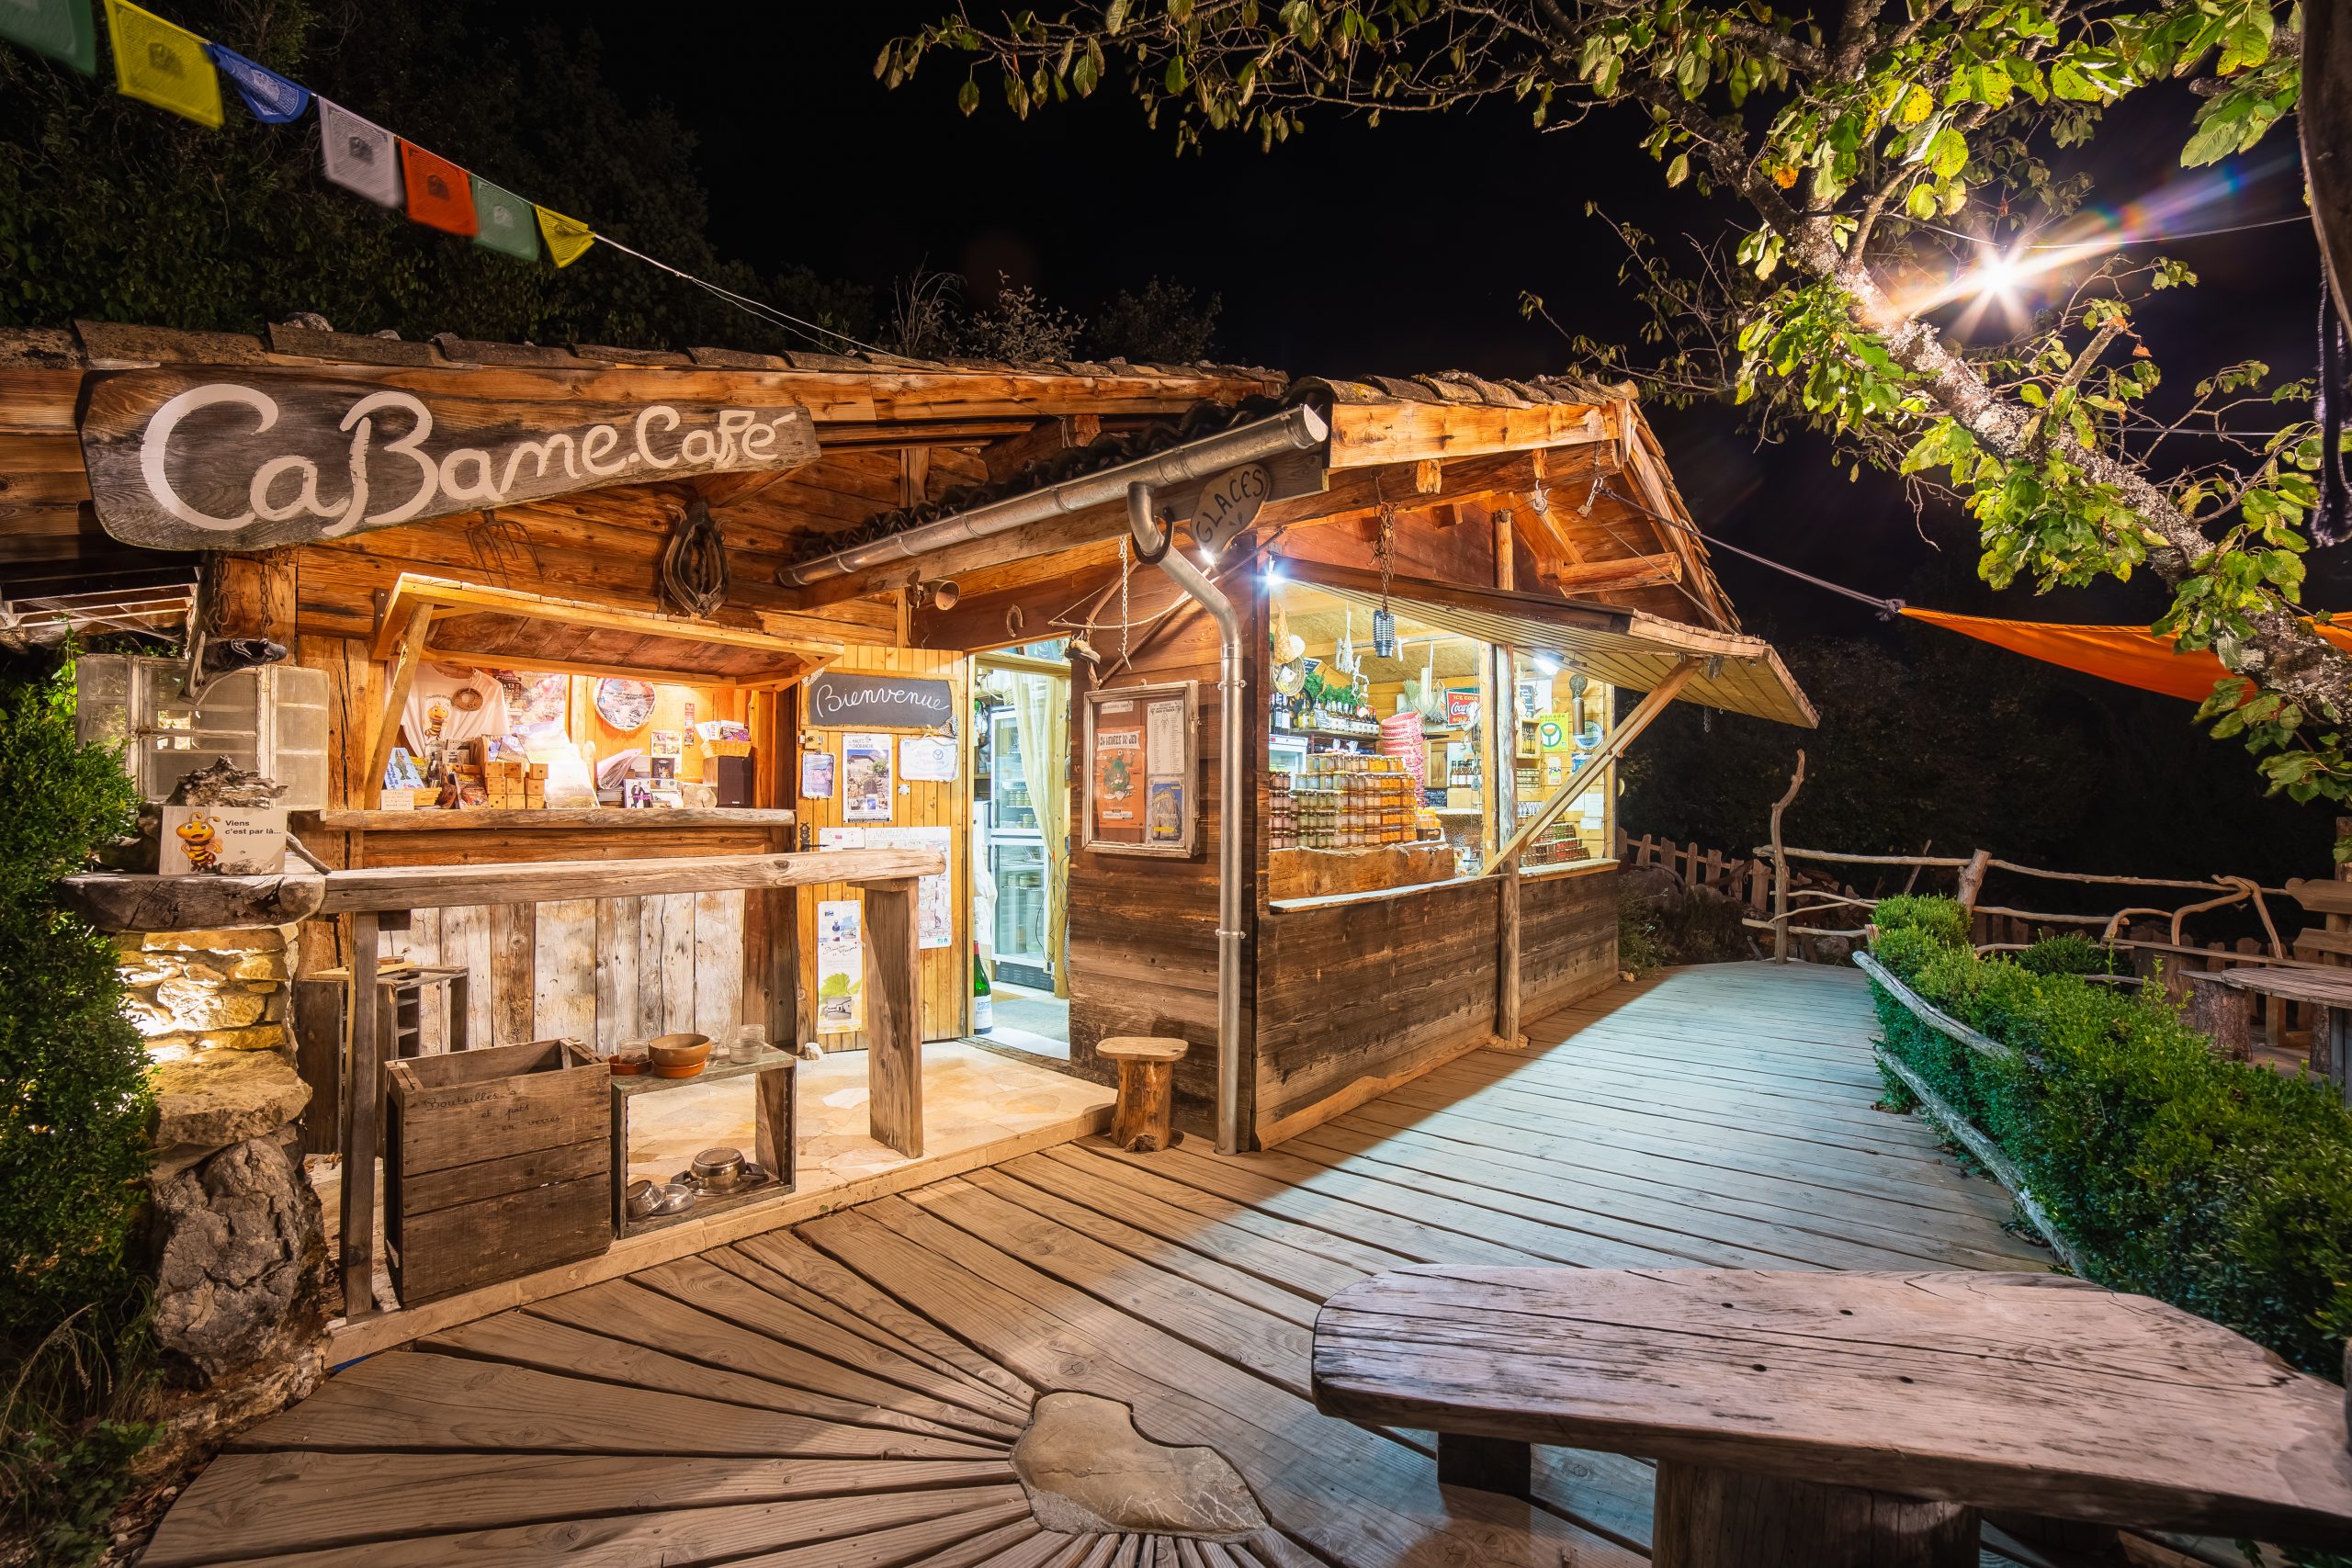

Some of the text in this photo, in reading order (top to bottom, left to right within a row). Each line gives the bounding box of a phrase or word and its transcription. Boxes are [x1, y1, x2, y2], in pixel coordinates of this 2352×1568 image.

[1195, 468, 1264, 544] GLACES
[816, 684, 950, 718] Bienvenue
[424, 1092, 499, 1111] Bouteilles
